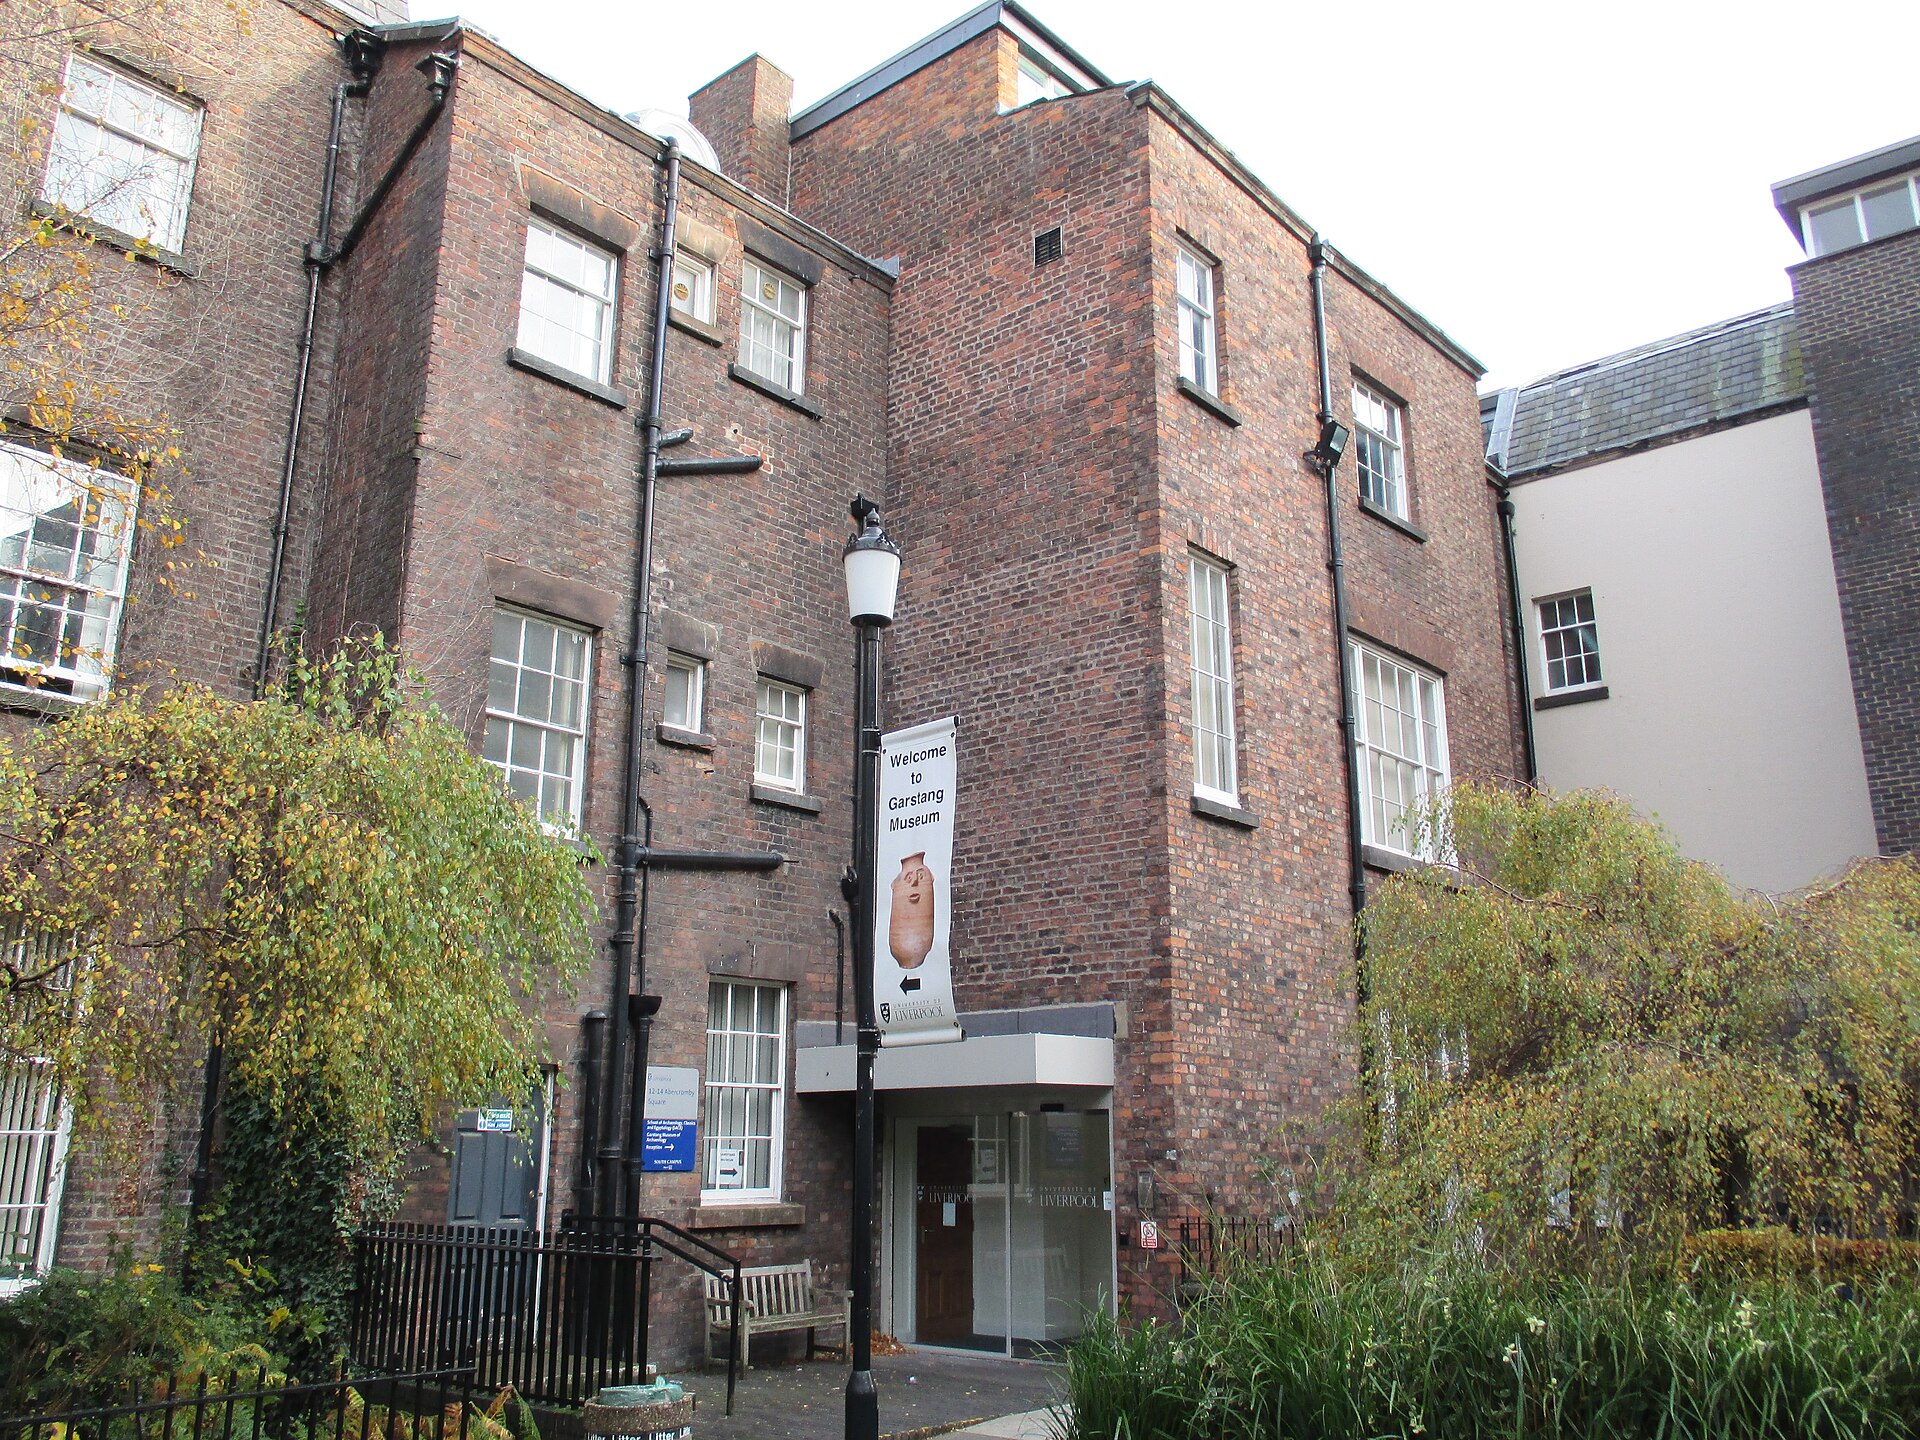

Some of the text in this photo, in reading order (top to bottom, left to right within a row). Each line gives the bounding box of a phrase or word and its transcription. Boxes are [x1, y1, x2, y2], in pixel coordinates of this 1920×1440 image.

[890, 745, 947, 768] Welcome
[911, 772, 922, 785] to
[888, 789, 944, 811] Garstang
[889, 811, 940, 832] Museum
[894, 1005, 946, 1022] LIVERPOOL
[648, 1097, 666, 1106] Square
[1039, 1194, 1100, 1208] LIVERPOOL
[649, 1432, 676, 1440] Litter
